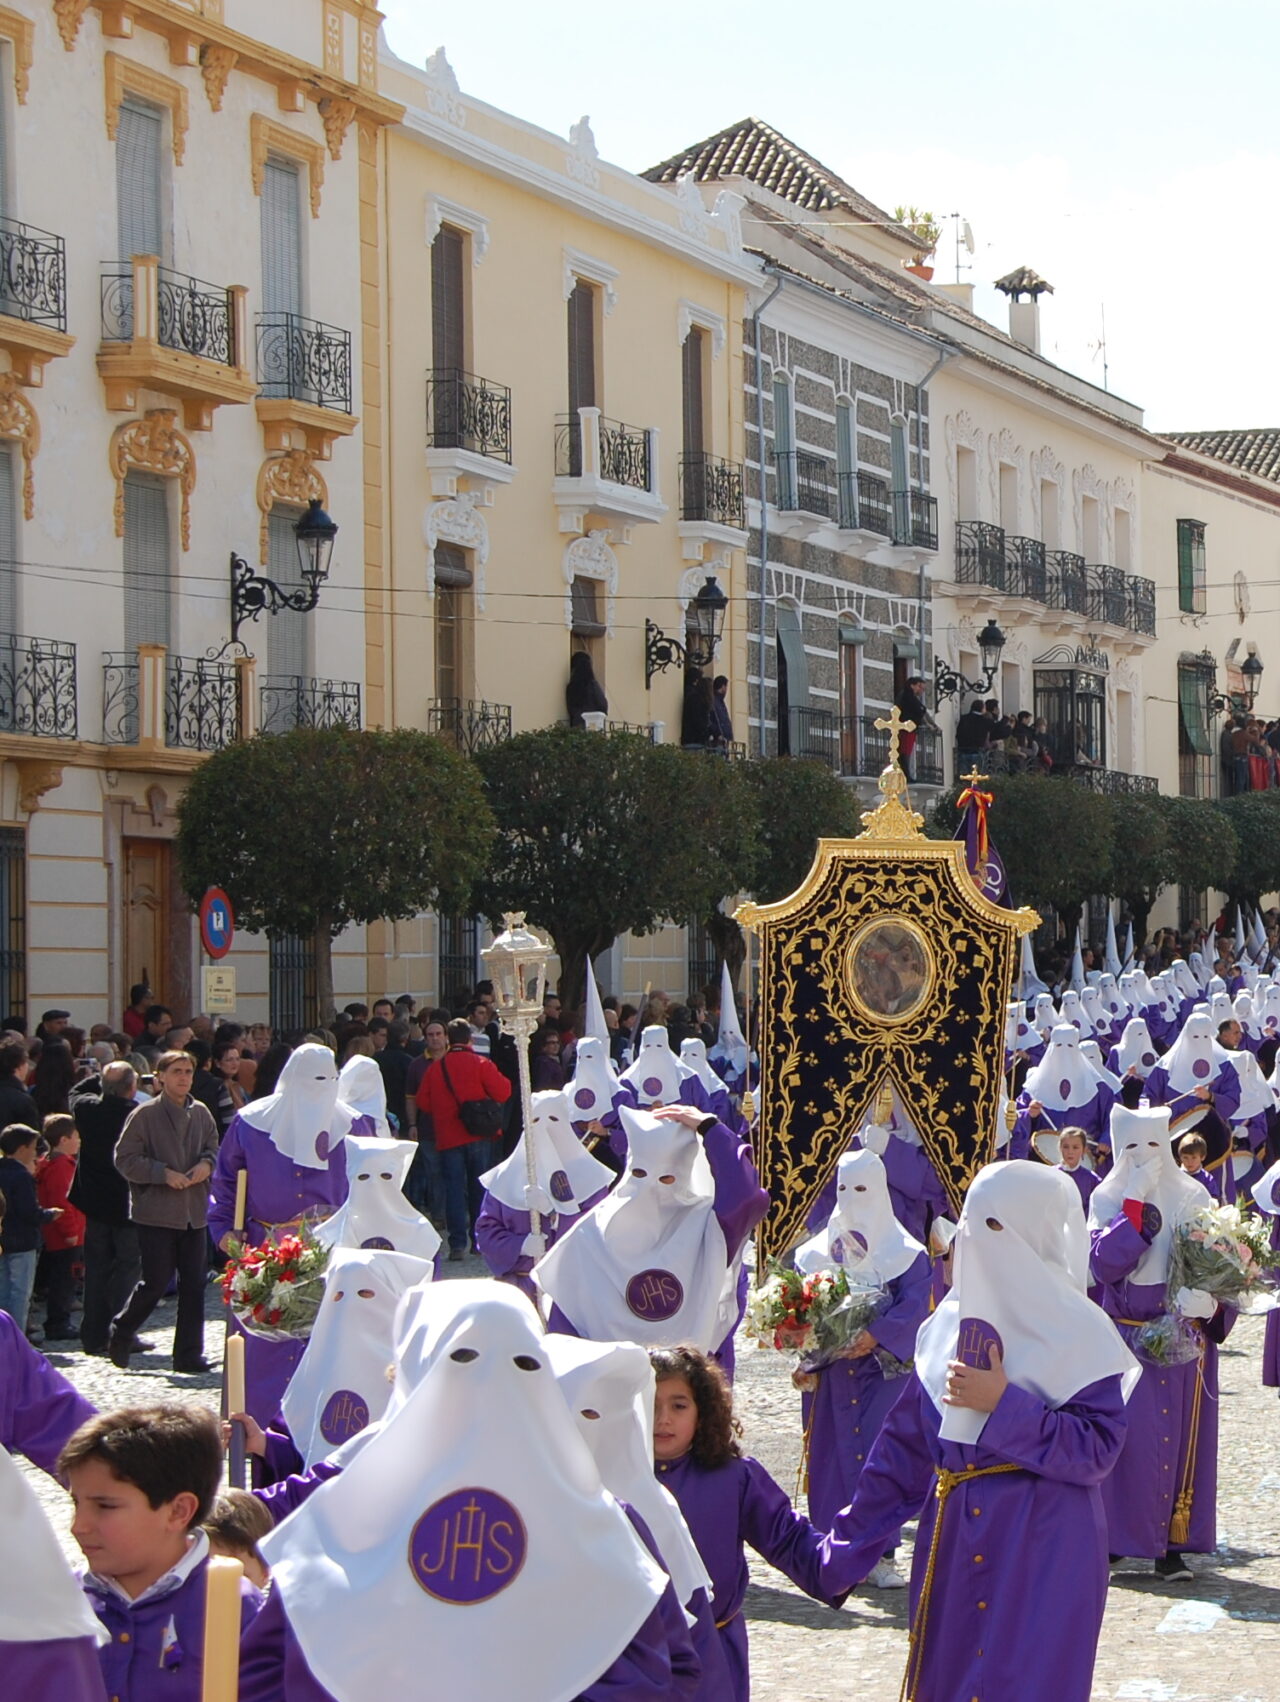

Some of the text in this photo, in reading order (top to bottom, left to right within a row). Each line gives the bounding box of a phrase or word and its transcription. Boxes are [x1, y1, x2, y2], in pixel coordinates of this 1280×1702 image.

[635, 1275, 677, 1311] JHS
[322, 1393, 366, 1435] JHS
[420, 1497, 513, 1582] JHS
